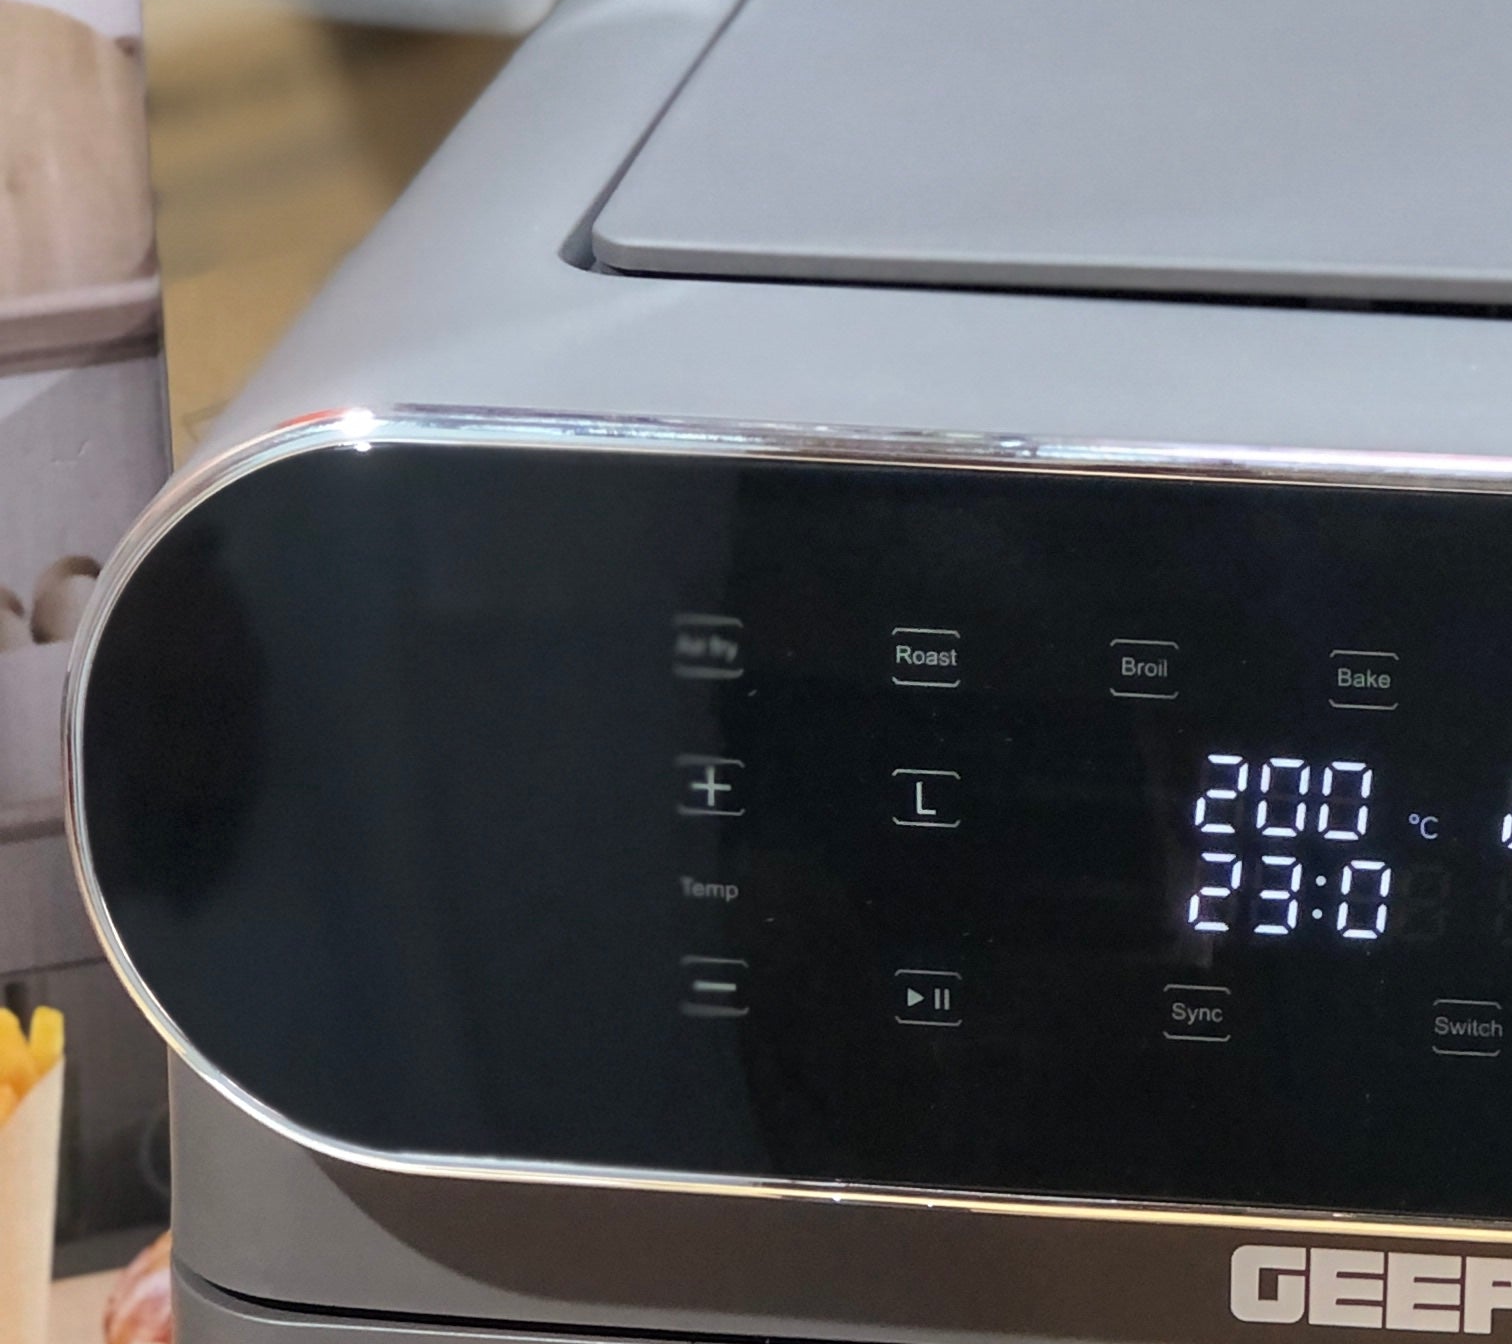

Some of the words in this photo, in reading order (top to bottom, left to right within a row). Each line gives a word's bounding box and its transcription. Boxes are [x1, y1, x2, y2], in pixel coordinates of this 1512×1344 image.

[896, 645, 956, 666] Roast
[1122, 657, 1167, 676] Broil
[1338, 668, 1390, 688] Bake
[916, 782, 936, 815] L
[1195, 755, 1372, 840] 200
[682, 877, 739, 902] Temp
[1172, 1003, 1222, 1025] Sync
[1435, 1017, 1502, 1036] Switch
